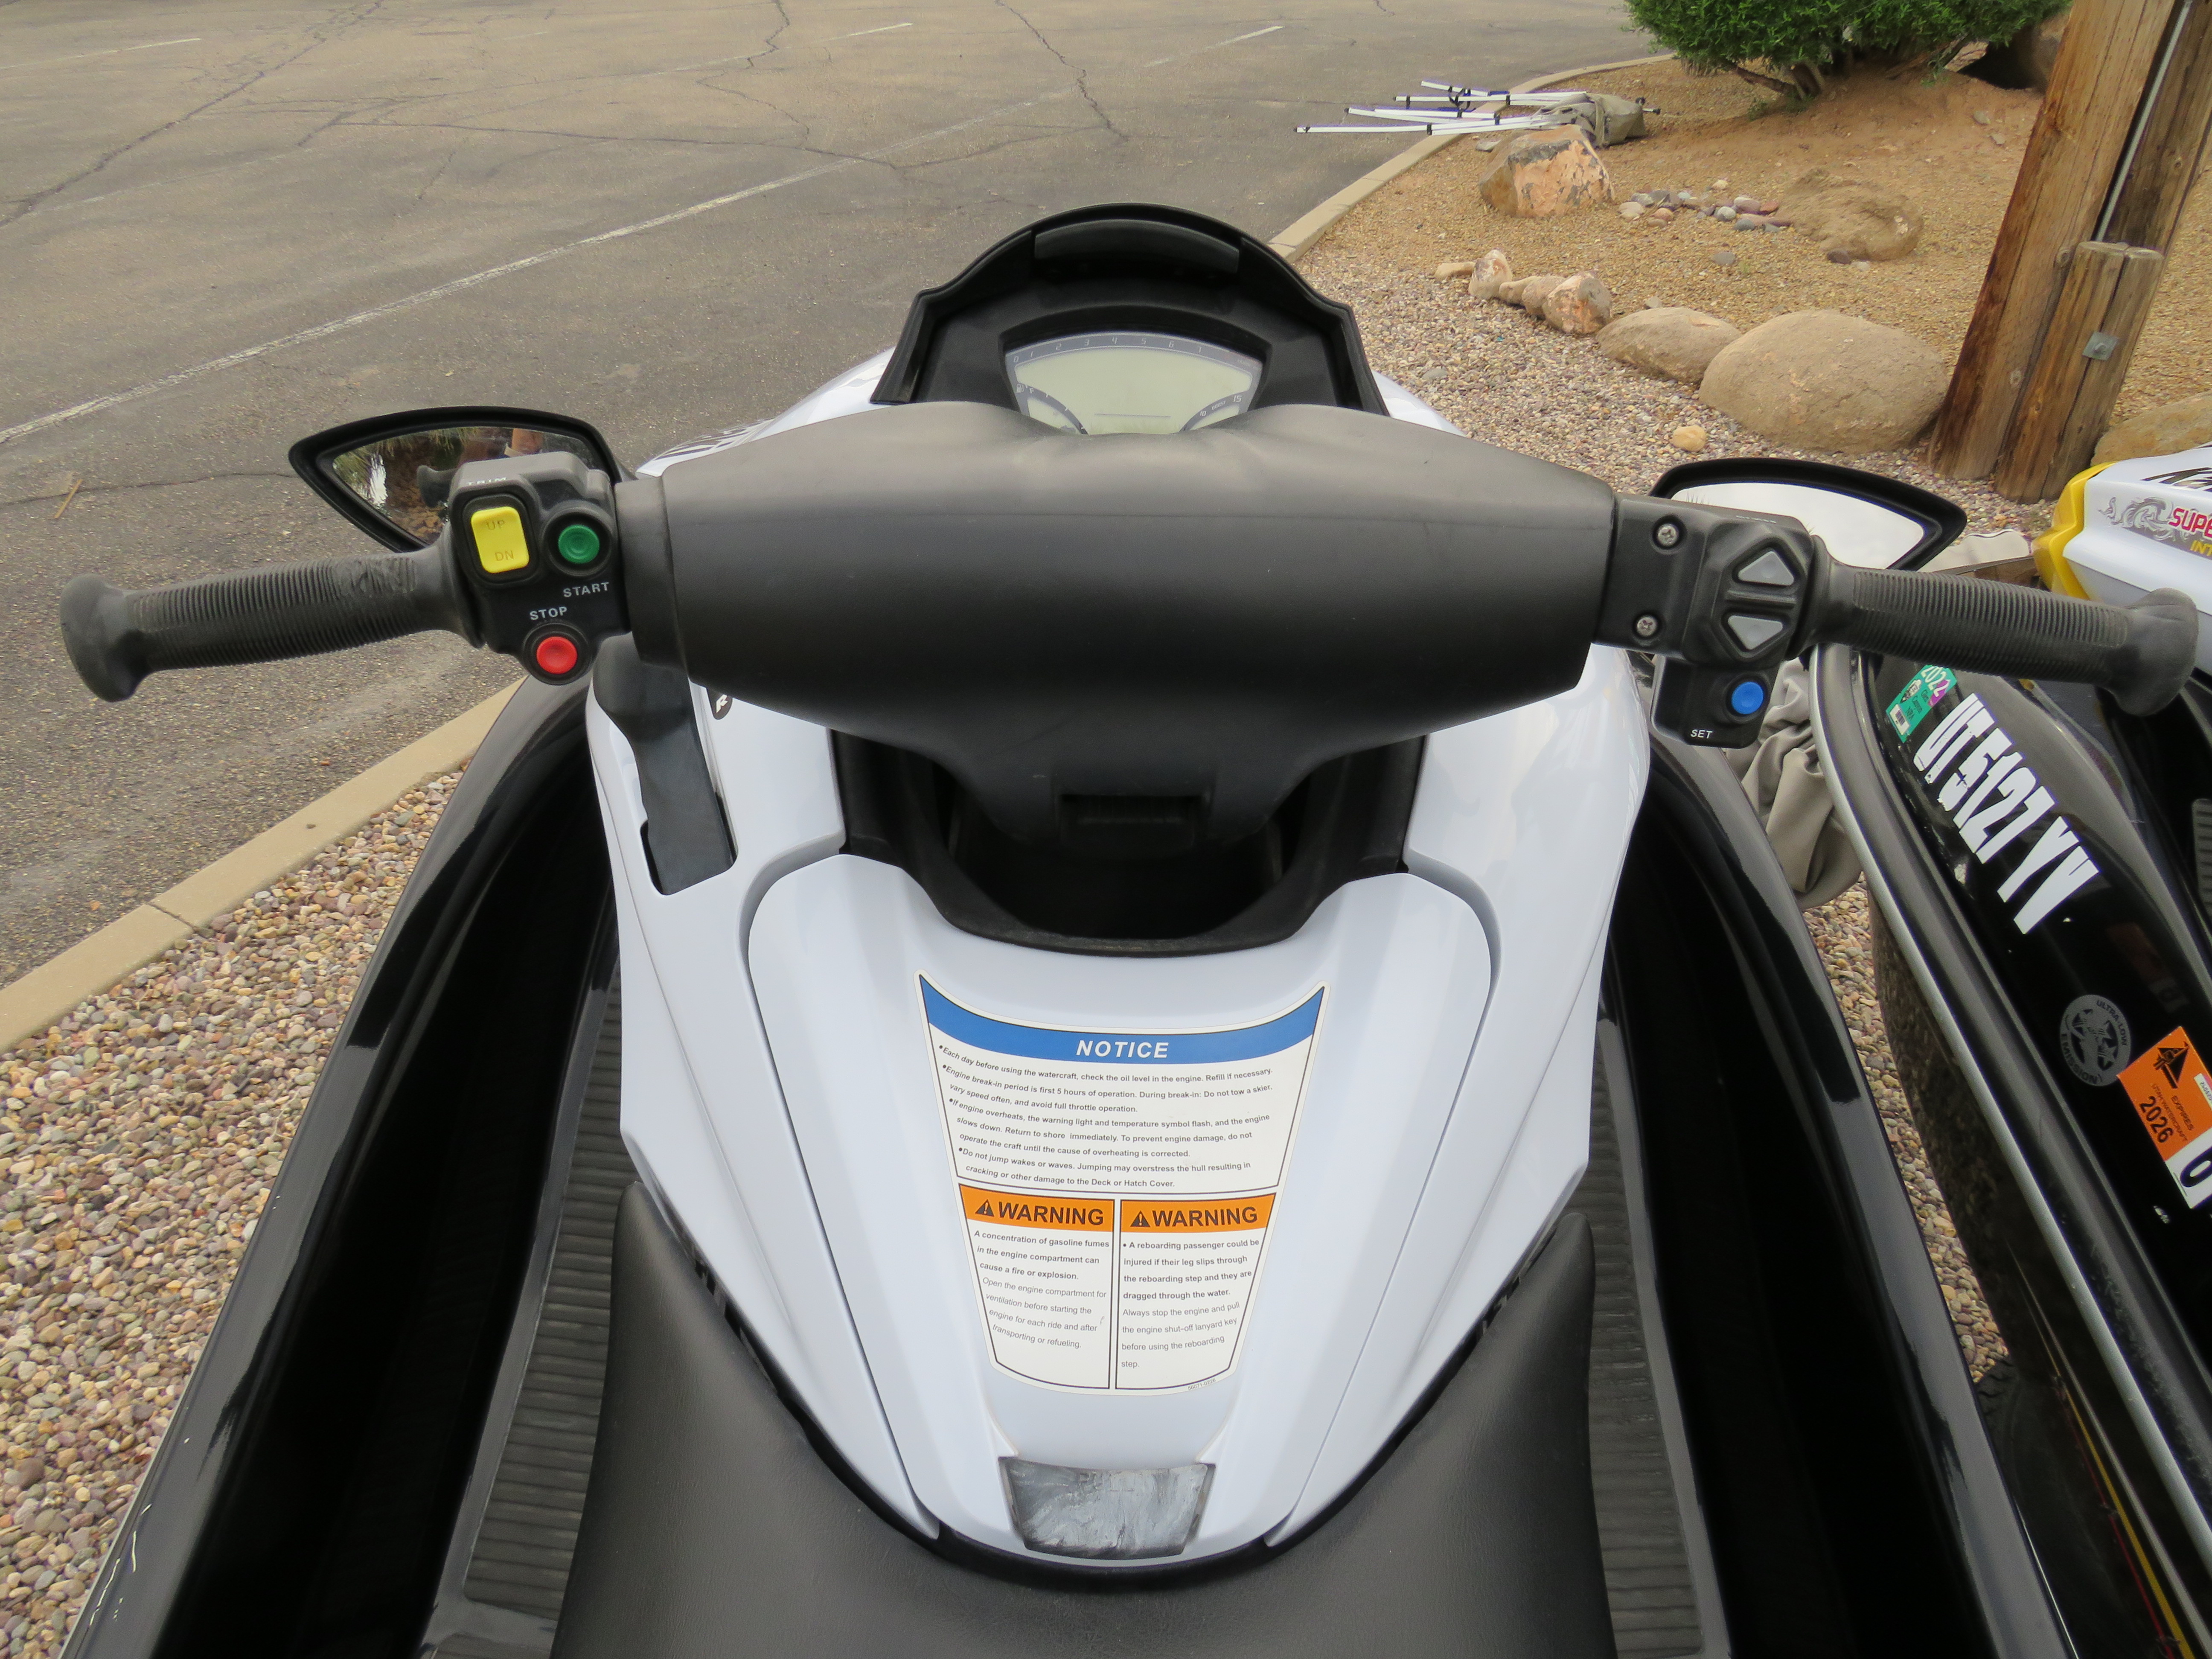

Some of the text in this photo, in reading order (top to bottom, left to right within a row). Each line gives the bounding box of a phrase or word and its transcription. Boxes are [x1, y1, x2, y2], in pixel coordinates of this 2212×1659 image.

[485, 519, 505, 531] UP
[495, 550, 514, 562] DN
[563, 582, 609, 597] START
[530, 606, 568, 620] STOP
[1690, 728, 1714, 739] SET
[1913, 693, 1996, 784] UT
[1937, 728, 2055, 864] 5127
[1076, 1040, 1169, 1059] NOTICE
[943, 1047, 960, 1060] Each
[960, 1056, 975, 1066] day
[975, 1060, 999, 1071] before
[1001, 1067, 1022, 1076] using
[1038, 1071, 1079, 1080] watercraft,
[1175, 1075, 1204, 1083] engine.
[1234, 1068, 1273, 1079] necessary.
[946, 1065, 971, 1080] Engine
[972, 1075, 1002, 1088] break-in
[1004, 1083, 1029, 1092] period
[1063, 1088, 1086, 1096] hours
[1139, 1091, 1166, 1100] During
[1252, 1085, 1273, 1093] skier,
[966, 1090, 990, 1100] speed
[990, 1095, 1012, 1105] often,
[1068, 1103, 1097, 1111] throttle
[959, 1103, 984, 1114] engine
[985, 1110, 1025, 1121] overheats,
[1042, 1117, 1074, 1126] warning
[1075, 1118, 1093, 1127] light
[1111, 1120, 1159, 1128] temperature
[1161, 1121, 1190, 1129] symbol
[1245, 1115, 1270, 1124] engine
[2139, 1096, 2174, 1143] 2026
[962, 1148, 973, 1157] Do
[988, 1154, 1009, 1164] jump
[1011, 1158, 1036, 1167] wakes
[1077, 1163, 1112, 1173] Jumping
[1208, 1163, 1242, 1171] resulting
[998, 1201, 1104, 1226] WARNING
[1152, 1206, 1258, 1228] WARNING
[982, 1232, 1037, 1244] concentration
[1085, 1240, 1110, 1248] fumes
[1137, 1242, 1181, 1251] reboarding
[1183, 1243, 1225, 1251] passenger
[1226, 1239, 1248, 1248] could
[977, 1245, 984, 1253] in
[986, 1248, 999, 1256] the
[1000, 1251, 1028, 1260] engine
[1030, 1254, 1083, 1263] compartment
[1123, 1258, 1152, 1267] injured
[1182, 1258, 1194, 1267] leg
[1196, 1258, 1215, 1266] slips
[1217, 1255, 1248, 1264] through
[979, 1263, 1003, 1272] cause
[1012, 1267, 1025, 1275] fire
[1037, 1271, 1079, 1280] explosion.
[1139, 1275, 1183, 1284] reboarding
[1185, 1275, 1202, 1283] step
[1204, 1273, 1219, 1281] and
[982, 1277, 1002, 1287] Open
[1004, 1282, 1016, 1290] the
[1018, 1285, 1043, 1294] engine
[1045, 1289, 1094, 1297] compartment
[1123, 1292, 1157, 1301] dragged
[1158, 1292, 1191, 1301] through
[1122, 1309, 1150, 1318] Always
[1152, 1309, 1168, 1318] stop
[1184, 1308, 1209, 1316] engine
[1211, 1304, 1225, 1313] and
[1227, 1301, 1240, 1312] pull
[1078, 1472, 1135, 1493] PULL
